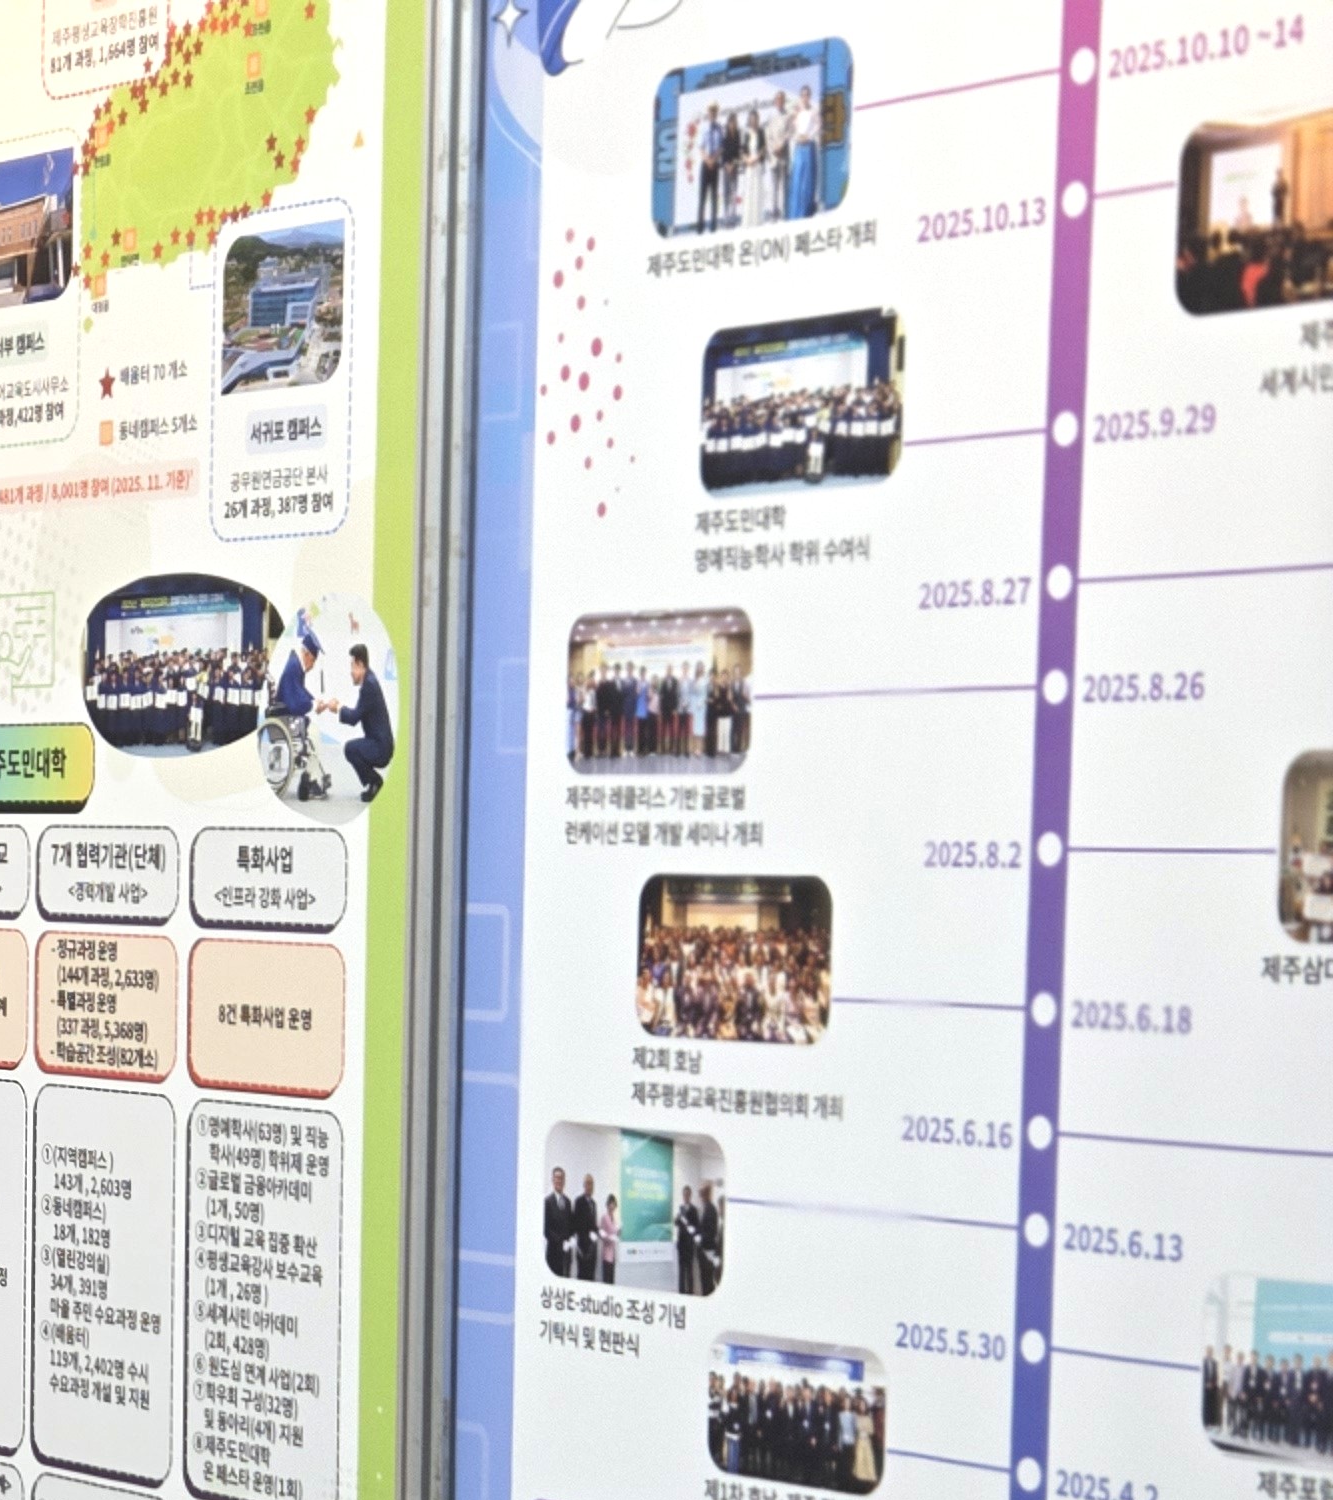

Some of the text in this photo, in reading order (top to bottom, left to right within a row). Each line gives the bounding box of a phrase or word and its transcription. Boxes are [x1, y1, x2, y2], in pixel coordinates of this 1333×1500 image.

[1107, 14, 1305, 80] 2025.10.10 ~14
[916, 196, 1047, 244] 2025.10.13
[1092, 402, 1217, 444] 2025.9.29
[918, 575, 1033, 611] 2025.8.27
[1082, 670, 1206, 704] 2025.8.26
[50, 841, 166, 873] 7개 협력기관(단체)
[236, 845, 294, 875] 특화사업
[923, 840, 1022, 870] 2025.8.2
[1070, 999, 1193, 1036] 2025.6.18
[900, 1114, 1014, 1150] 2025.6.16
[1063, 1222, 1184, 1264] 2025.6.13
[894, 1321, 1007, 1363] 2025.5.30
